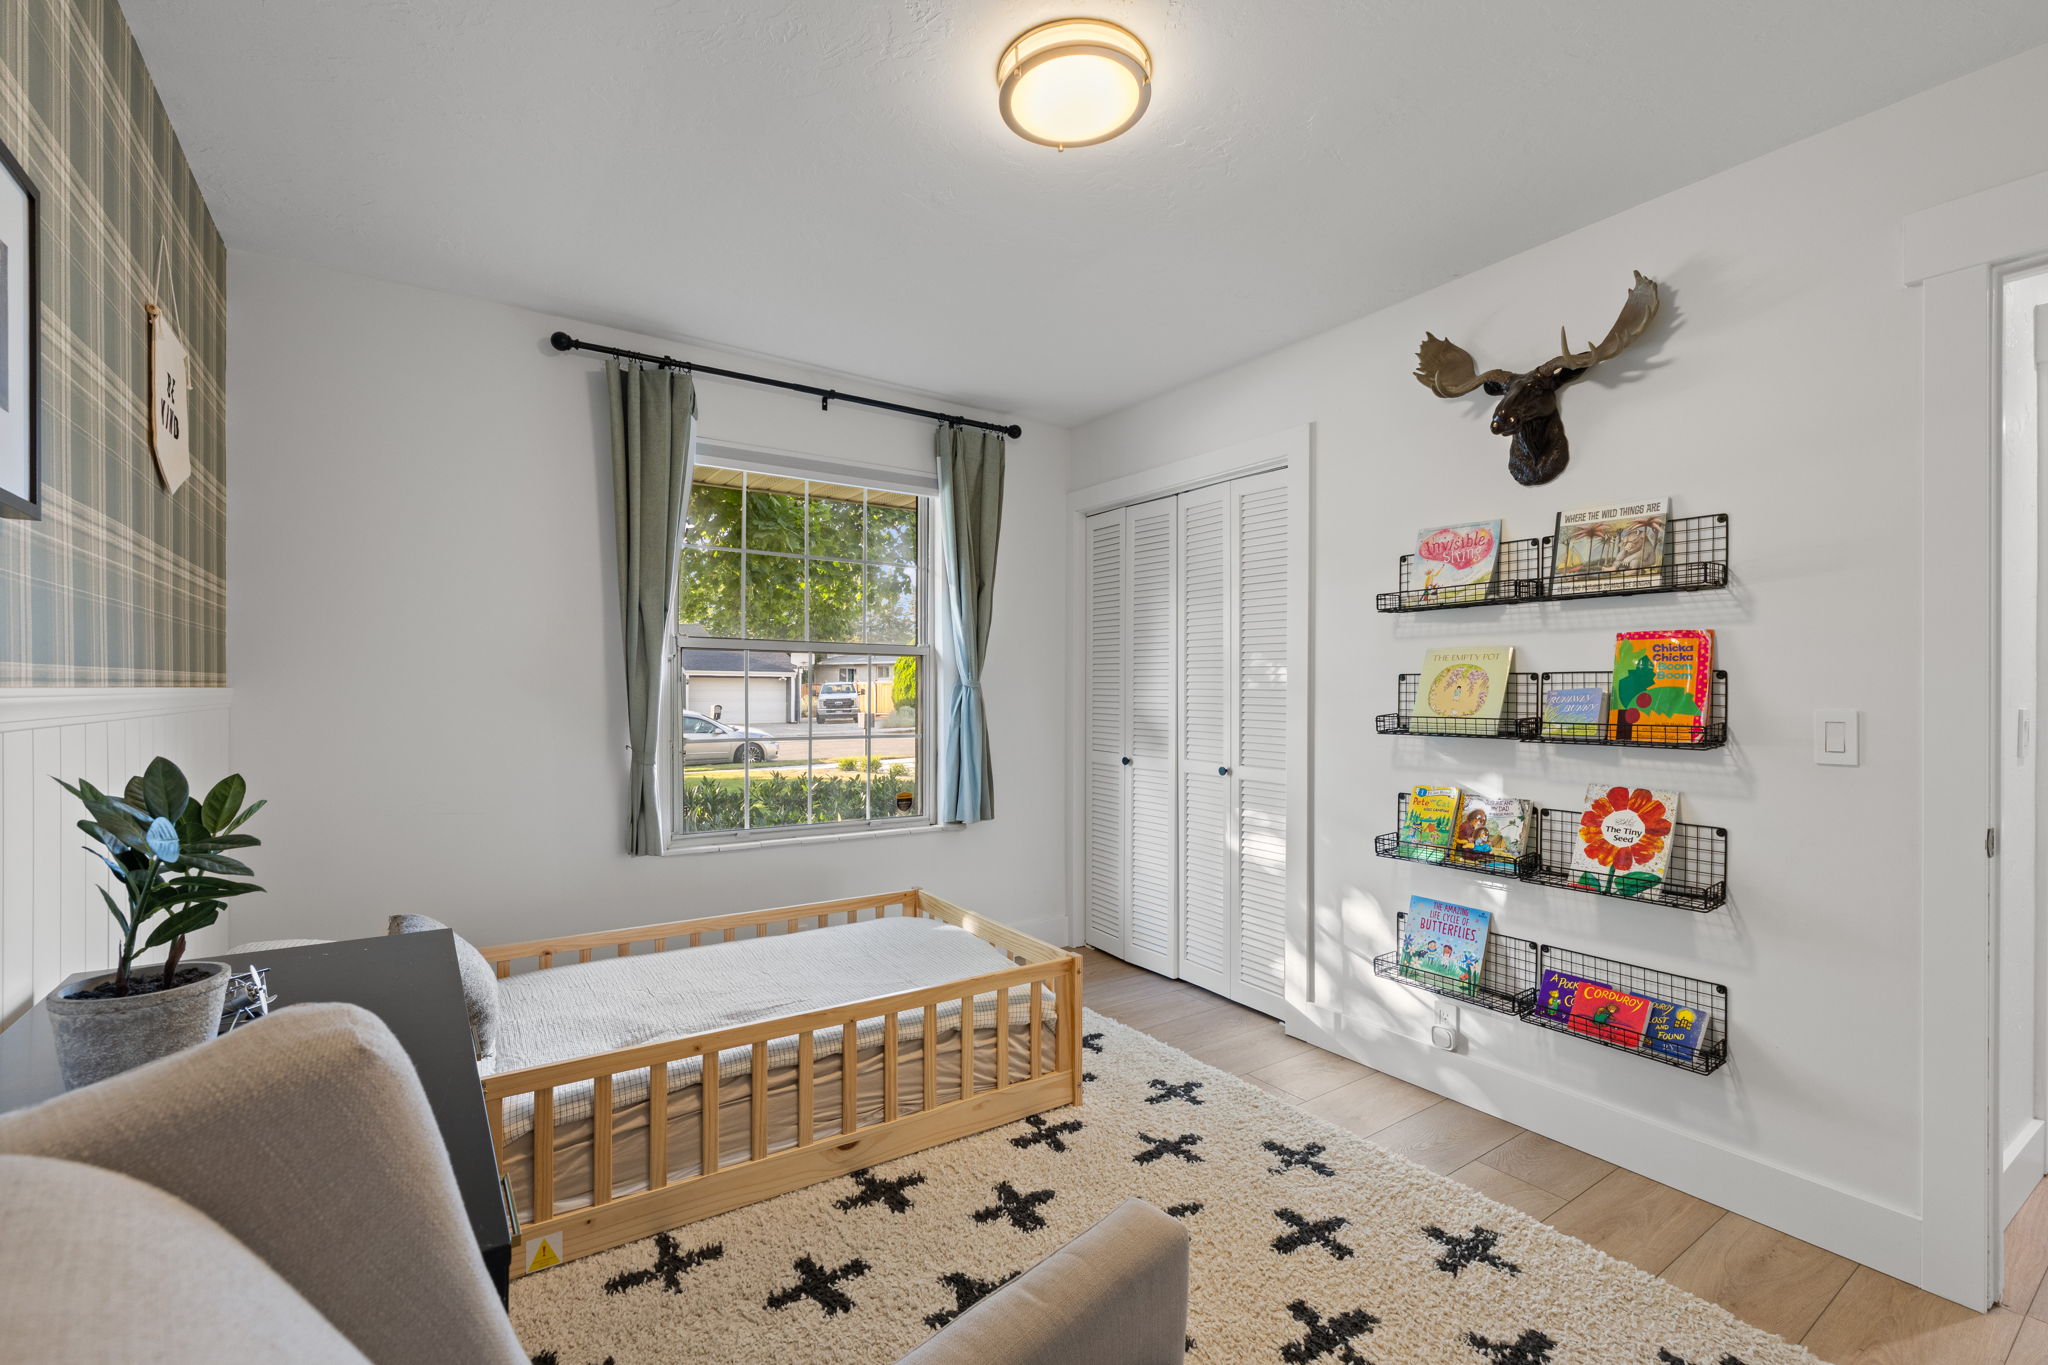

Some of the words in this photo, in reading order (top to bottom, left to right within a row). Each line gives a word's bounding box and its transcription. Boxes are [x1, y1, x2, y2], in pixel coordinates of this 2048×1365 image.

[166, 372, 176, 405] BE
[160, 398, 180, 440] KIND
[1564, 512, 1587, 524] WHERE
[1588, 510, 1600, 521] THE
[1601, 508, 1618, 519] WILD
[1619, 504, 1645, 517] THINGS
[1646, 502, 1661, 513] ARE
[1425, 531, 1486, 556] Invisible
[1652, 643, 1694, 652] Chicka
[1433, 654, 1449, 662] THE
[1451, 653, 1480, 661] EMPTY
[1482, 652, 1500, 660] POT
[1652, 653, 1694, 662] Chicka
[1657, 662, 1693, 671] Boom
[1656, 671, 1693, 680] Boom
[1412, 796, 1430, 806] Pete
[1605, 825, 1622, 834] The
[1623, 827, 1643, 838] Tiny
[1613, 834, 1634, 843] Seed
[1433, 901, 1443, 911] THE
[1444, 904, 1469, 916] AMAZING
[1429, 910, 1441, 920] LIFE
[1443, 913, 1460, 924] CYCLE
[1462, 917, 1470, 926] OF
[1420, 917, 1477, 942] BUTTERFLIES
[1550, 973, 1559, 983] A
[1558, 977, 1579, 989] POCK
[1583, 986, 1644, 1013] CORDUROY
[1657, 1031, 1685, 1041] FOUND
